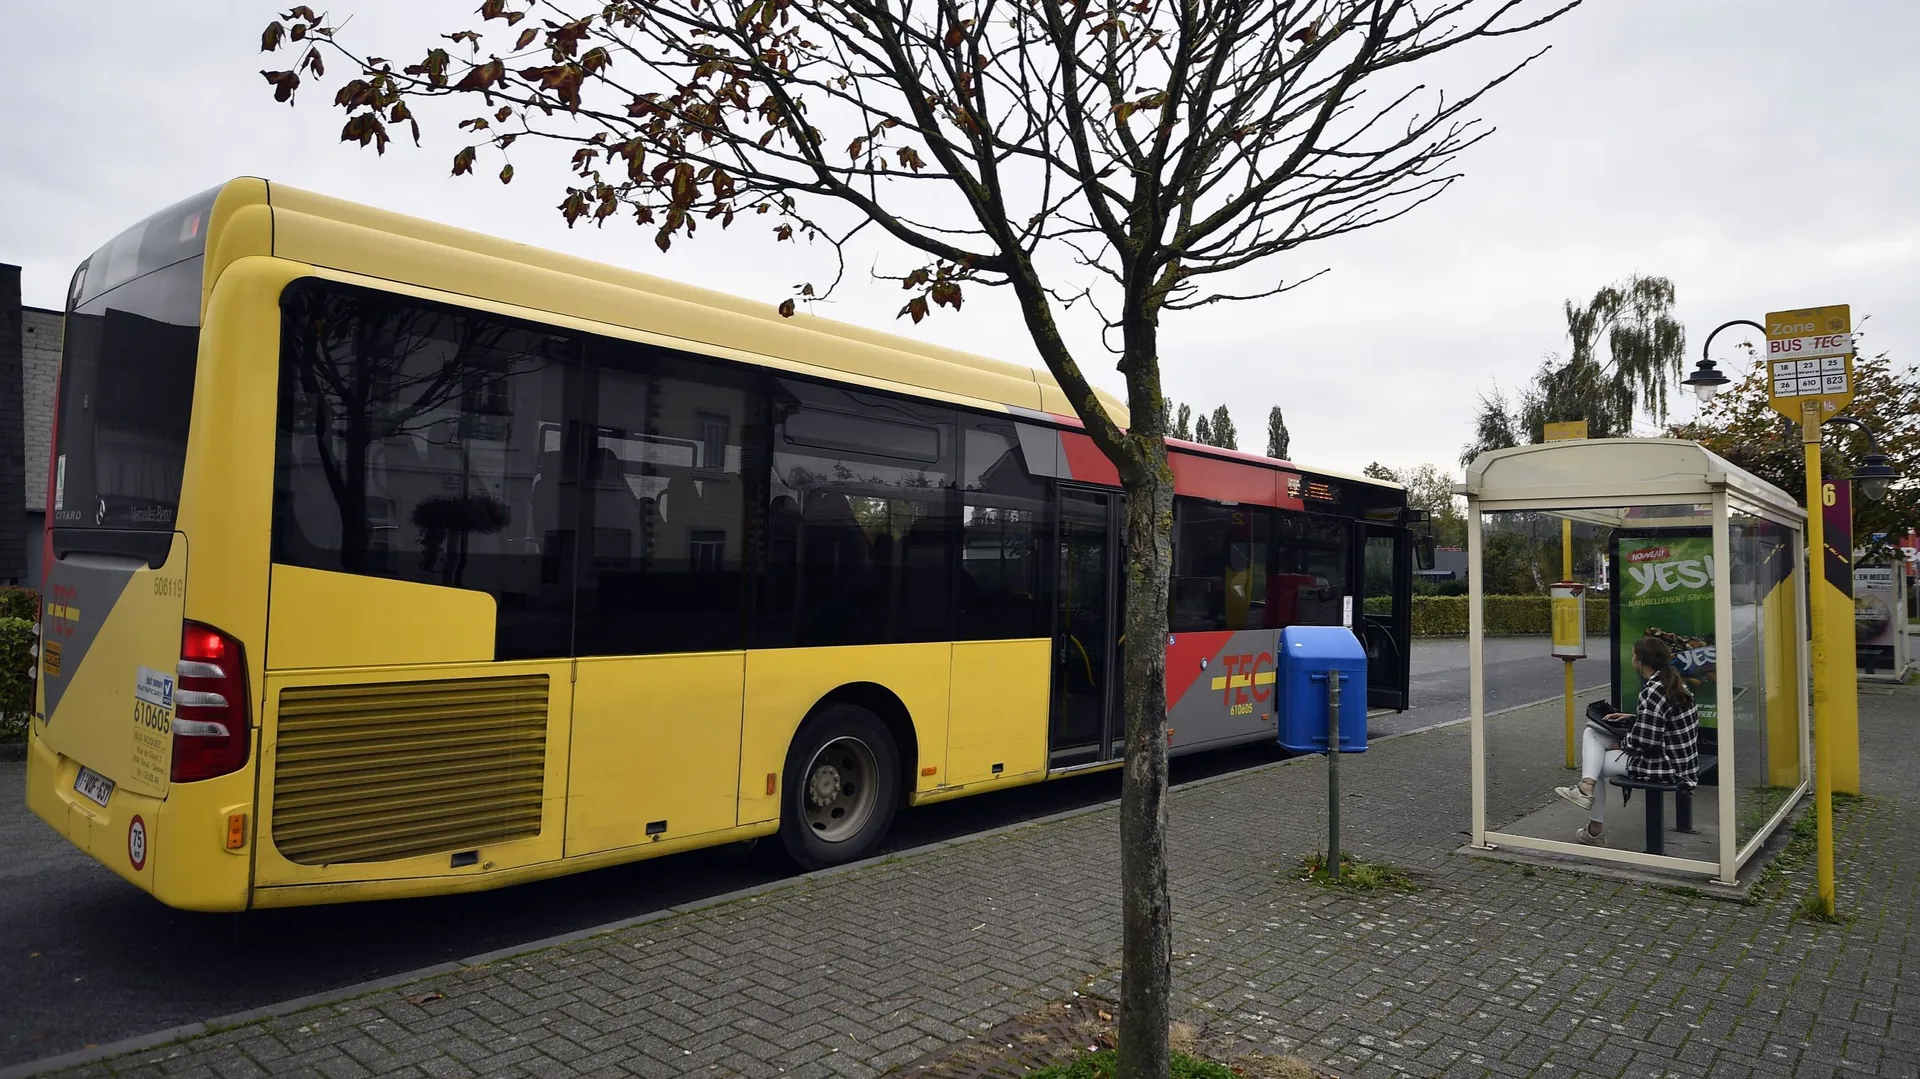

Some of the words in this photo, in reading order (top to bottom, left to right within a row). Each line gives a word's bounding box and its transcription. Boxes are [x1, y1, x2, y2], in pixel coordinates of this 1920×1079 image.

[1770, 322, 1816, 336] Zone
[1770, 338, 1802, 353] BUS
[1813, 335, 1843, 349] TEC
[1802, 379, 1817, 387] 610
[1826, 376, 1844, 385] 823
[1822, 483, 1836, 507] 6
[55, 511, 82, 520] CITARO
[130, 505, 173, 522] Mercedes-Benz
[1631, 550, 1664, 561] NOUVEAU
[1859, 573, 1868, 581] EN
[154, 576, 183, 598] 506119
[1628, 595, 1685, 607] NATURELLEMENT
[52, 584, 77, 638] TEC
[1222, 652, 1273, 707] TEC
[1229, 703, 1253, 716] 610605
[134, 701, 170, 734] 610605
[133, 829, 142, 849] 75
